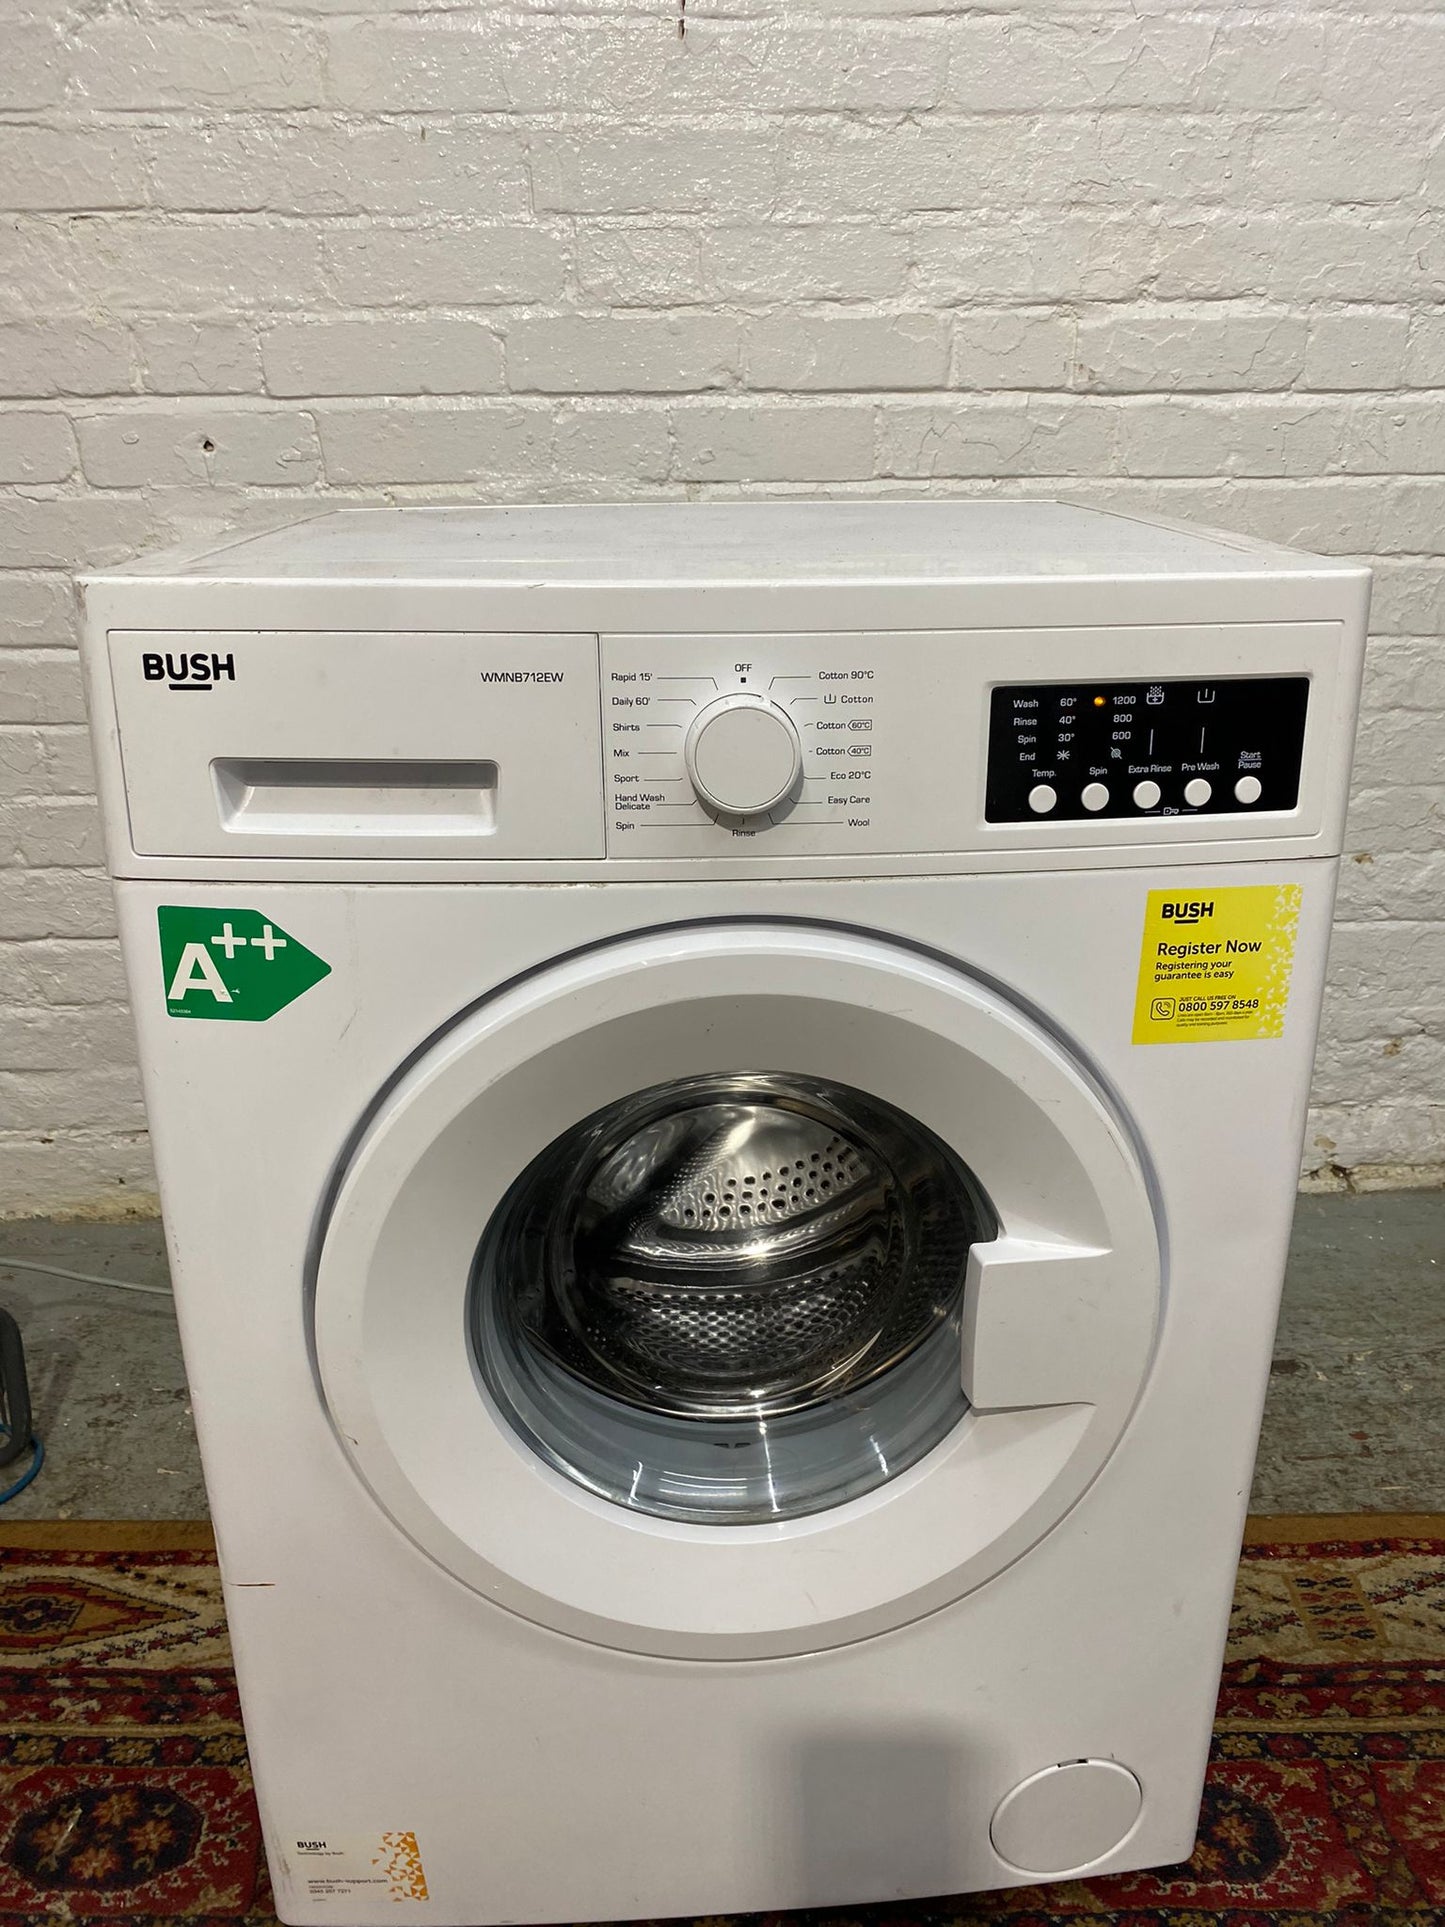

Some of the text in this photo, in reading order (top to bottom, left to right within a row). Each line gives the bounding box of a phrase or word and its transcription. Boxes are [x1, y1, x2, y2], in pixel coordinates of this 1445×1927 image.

[142, 653, 235, 690] BUSH
[735, 664, 752, 672] OFF
[480, 672, 564, 683] WMNB712EW
[611, 673, 636, 682] Rapid
[819, 670, 874, 679] Cotton 90°C
[612, 697, 633, 707] Daily
[841, 695, 873, 703] Cotton
[1013, 699, 1038, 708] Wash
[1060, 698, 1077, 707] 60°
[1112, 696, 1136, 705] 1200
[1013, 718, 1037, 726] Rinse
[1059, 716, 1076, 725] 40°
[1113, 714, 1132, 723] 800
[613, 723, 640, 731] Shirts
[817, 722, 846, 730] Cotton
[1018, 735, 1036, 745] Spin
[1058, 733, 1075, 742] 30°
[1112, 731, 1131, 740] 600
[816, 747, 845, 755] Cotton
[1240, 751, 1261, 759] Start
[1020, 752, 1036, 761] End
[1128, 764, 1172, 774] Extra Rinse
[1182, 762, 1220, 771] Pre Wash
[1238, 761, 1261, 769] Pause
[830, 772, 871, 780] Eco 20°C
[1032, 769, 1057, 779] Temp.
[1089, 767, 1108, 776] Spin
[614, 775, 639, 784] Sport
[615, 794, 665, 802] Hand Wash
[828, 796, 870, 806] Easy Care
[616, 822, 634, 831] Spin
[848, 819, 869, 827] Wool
[732, 829, 756, 837] Rinse
[1162, 902, 1214, 923] BUSH
[1157, 940, 1262, 958] Register Now
[1156, 961, 1232, 971] Registering your
[1154, 972, 1202, 982] guarantee
[1214, 970, 1234, 979] easy
[1179, 999, 1259, 1011] 0800 597 8548
[297, 1842, 326, 1850] BUSH
